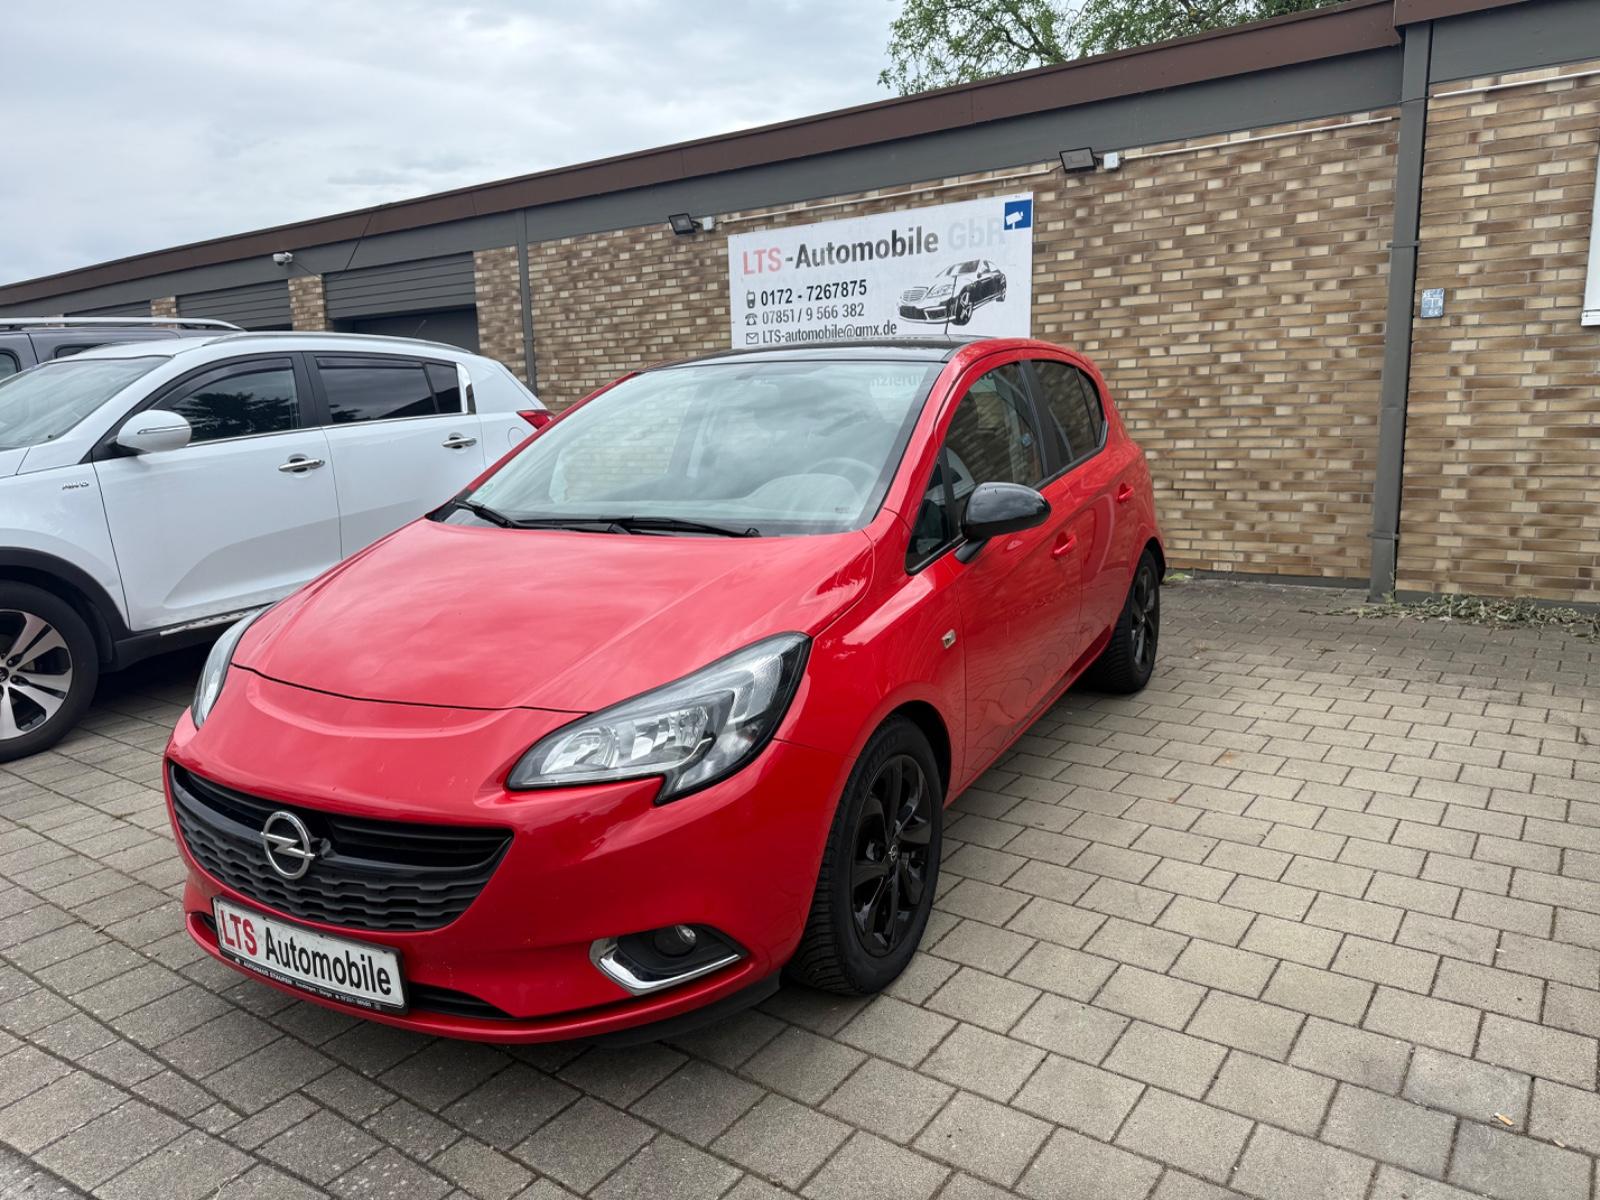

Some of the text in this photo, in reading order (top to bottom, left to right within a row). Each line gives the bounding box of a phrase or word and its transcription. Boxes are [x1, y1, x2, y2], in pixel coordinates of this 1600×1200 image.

[761, 288, 793, 306] 0172
[806, 279, 867, 302] 7267875
[806, 307, 813, 321] 9
[816, 305, 838, 320] 566
[842, 302, 865, 318] 382
[220, 908, 392, 996] LTS Automobile
